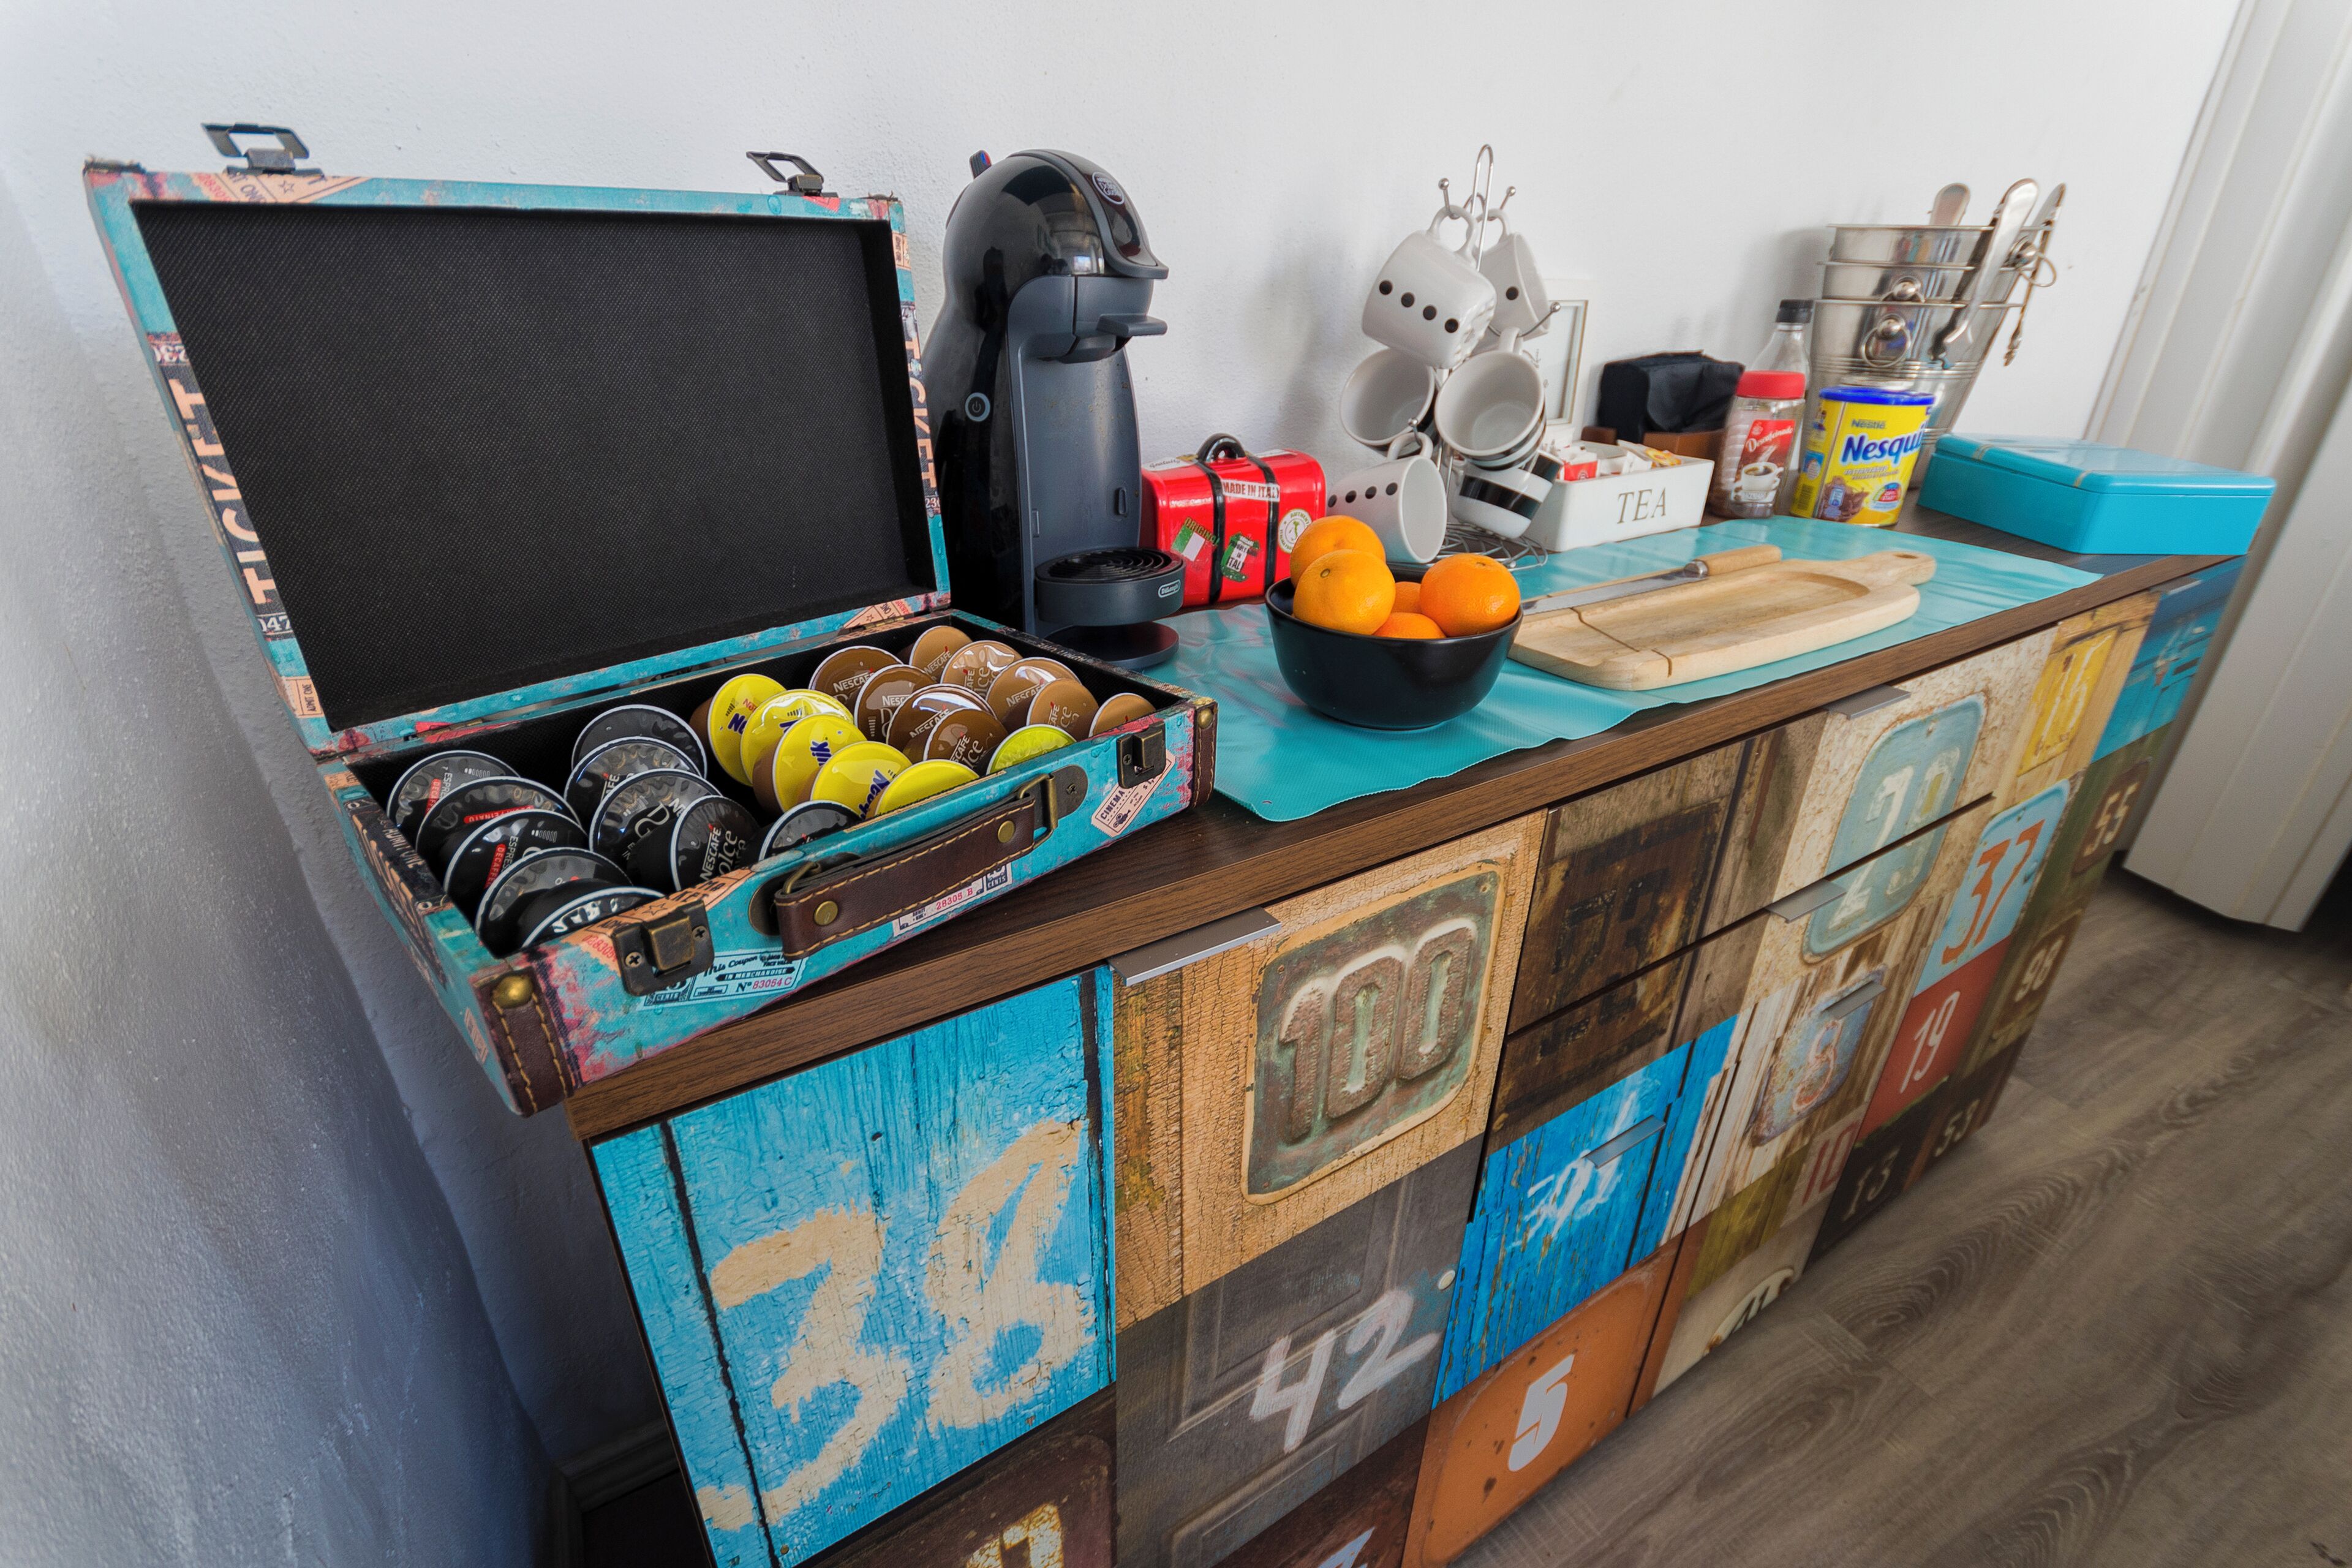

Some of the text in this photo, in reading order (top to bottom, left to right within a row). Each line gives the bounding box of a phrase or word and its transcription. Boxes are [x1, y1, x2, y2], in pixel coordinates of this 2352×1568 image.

[1223, 482, 1280, 500] MADE IN ITALY
[1617, 487, 1666, 524] TEA
[1100, 790, 1126, 820] CINEMA
[2083, 782, 2139, 858] 55
[936, 887, 974, 911] 28305 B
[987, 875, 1007, 889] CENTS
[1941, 818, 2046, 966] 37
[728, 956, 758, 969] Coupon
[2015, 935, 2067, 1003] 98
[1280, 917, 1477, 1145] 100
[1899, 991, 1961, 1095] 19
[1250, 1288, 1442, 1455] 42
[1508, 1354, 1574, 1472] 5
